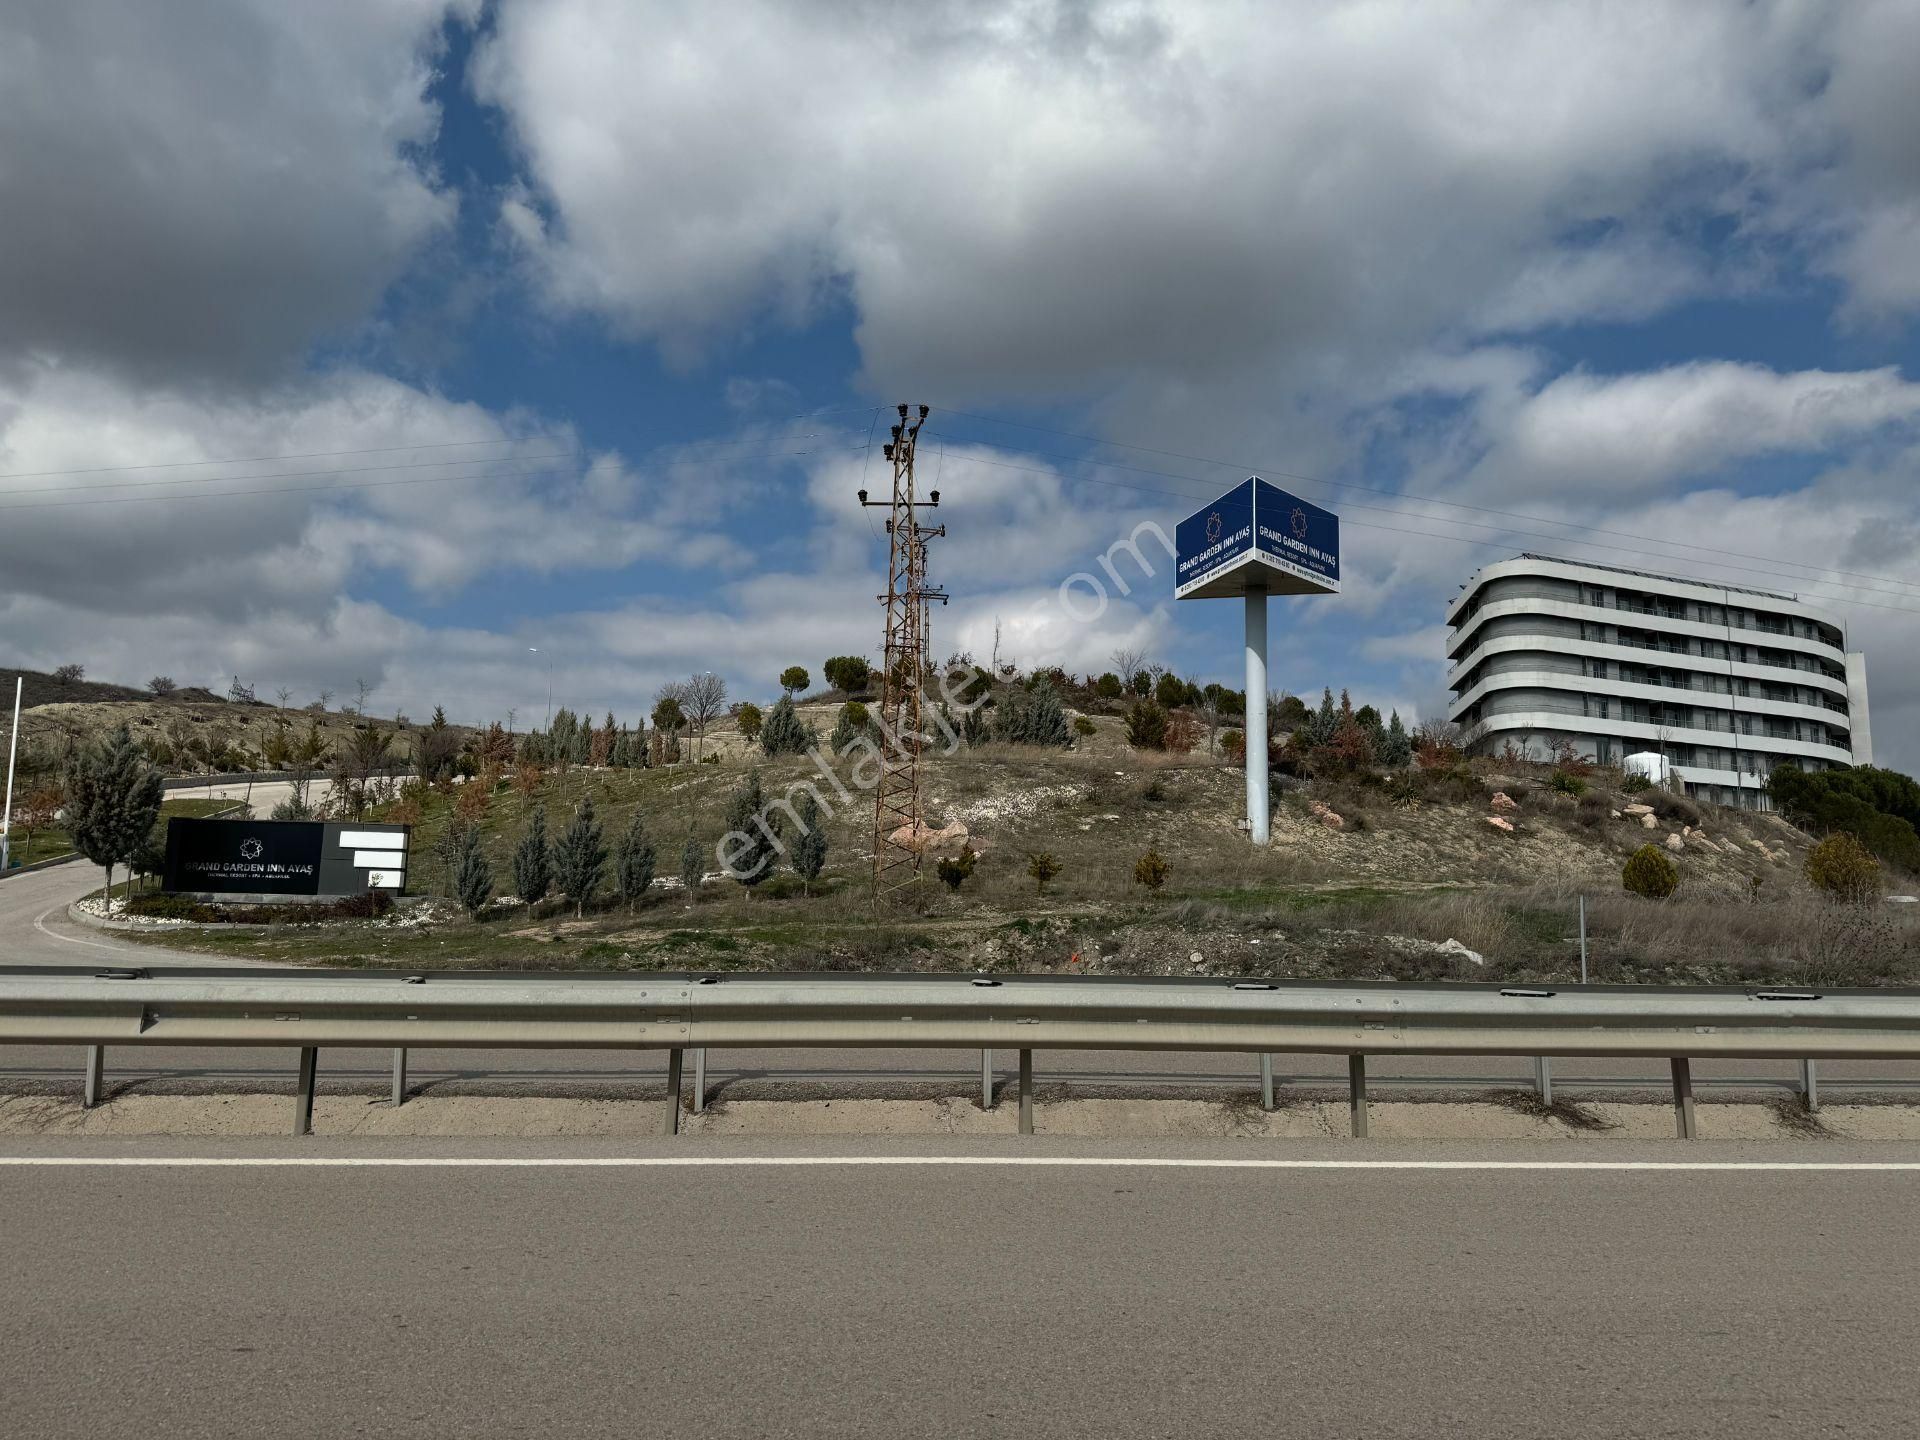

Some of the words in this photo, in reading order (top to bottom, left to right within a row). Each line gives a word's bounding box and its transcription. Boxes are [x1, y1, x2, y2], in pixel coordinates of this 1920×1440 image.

[1179, 556, 1199, 573] GRAND
[1200, 542, 1222, 563] GARDEN
[1223, 535, 1234, 549] INN
[1260, 525, 1282, 543] GRAND
[1283, 536, 1308, 555] GARDEN
[1309, 546, 1320, 559] INN
[1321, 552, 1336, 568] AYAŞ
[184, 862, 220, 871] GRAND
[223, 862, 264, 872] GARDEN
[267, 863, 285, 873] INN
[287, 864, 314, 876] AYAŞ
